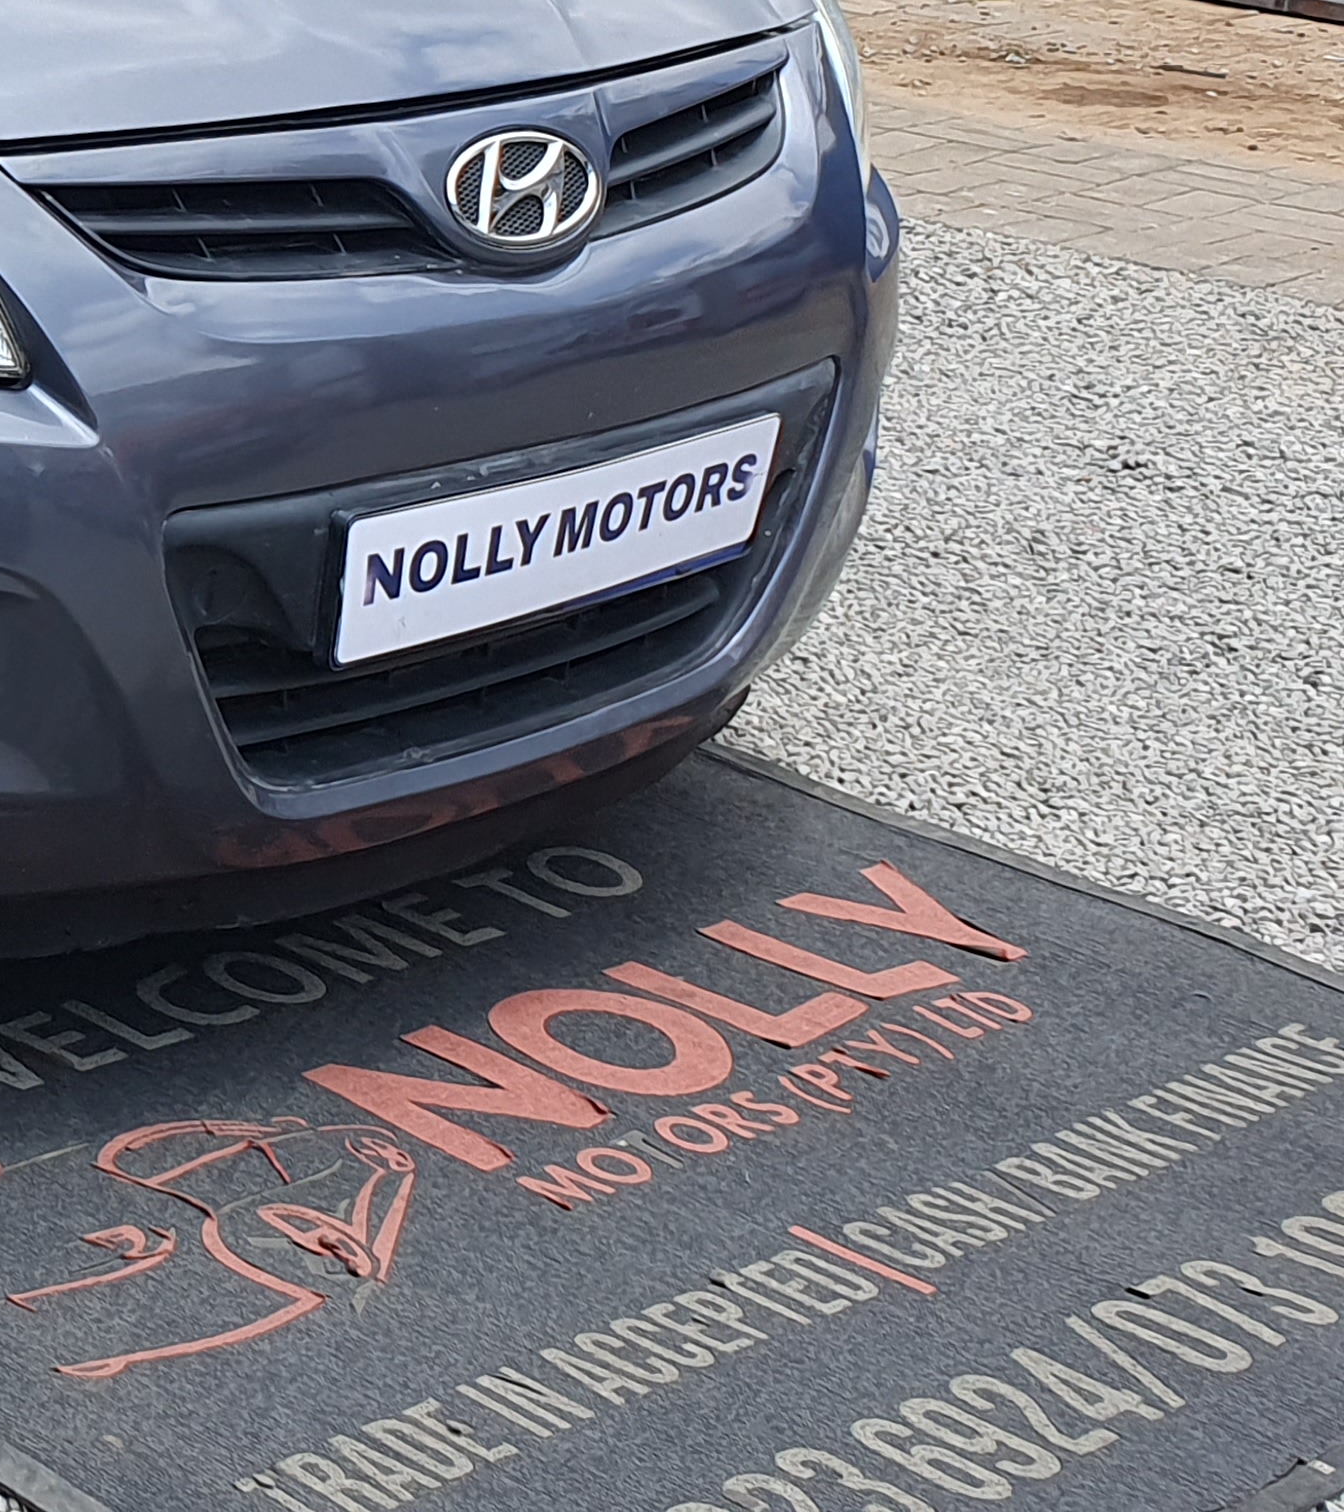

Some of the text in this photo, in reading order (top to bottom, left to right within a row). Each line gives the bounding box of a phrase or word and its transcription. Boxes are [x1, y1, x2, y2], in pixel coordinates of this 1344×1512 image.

[362, 453, 758, 606] NOLLY MOTORS
[453, 845, 644, 918] TO
[302, 860, 1029, 1171] NOLLY
[516, 1090, 800, 1210] MOTORS
[913, 991, 1034, 1040] LTD
[233, 1398, 519, 1512] TRADE
[454, 1366, 596, 1438] IN
[540, 1249, 880, 1406] ACCEPTED
[1128, 1022, 1344, 1141] FINANCE
